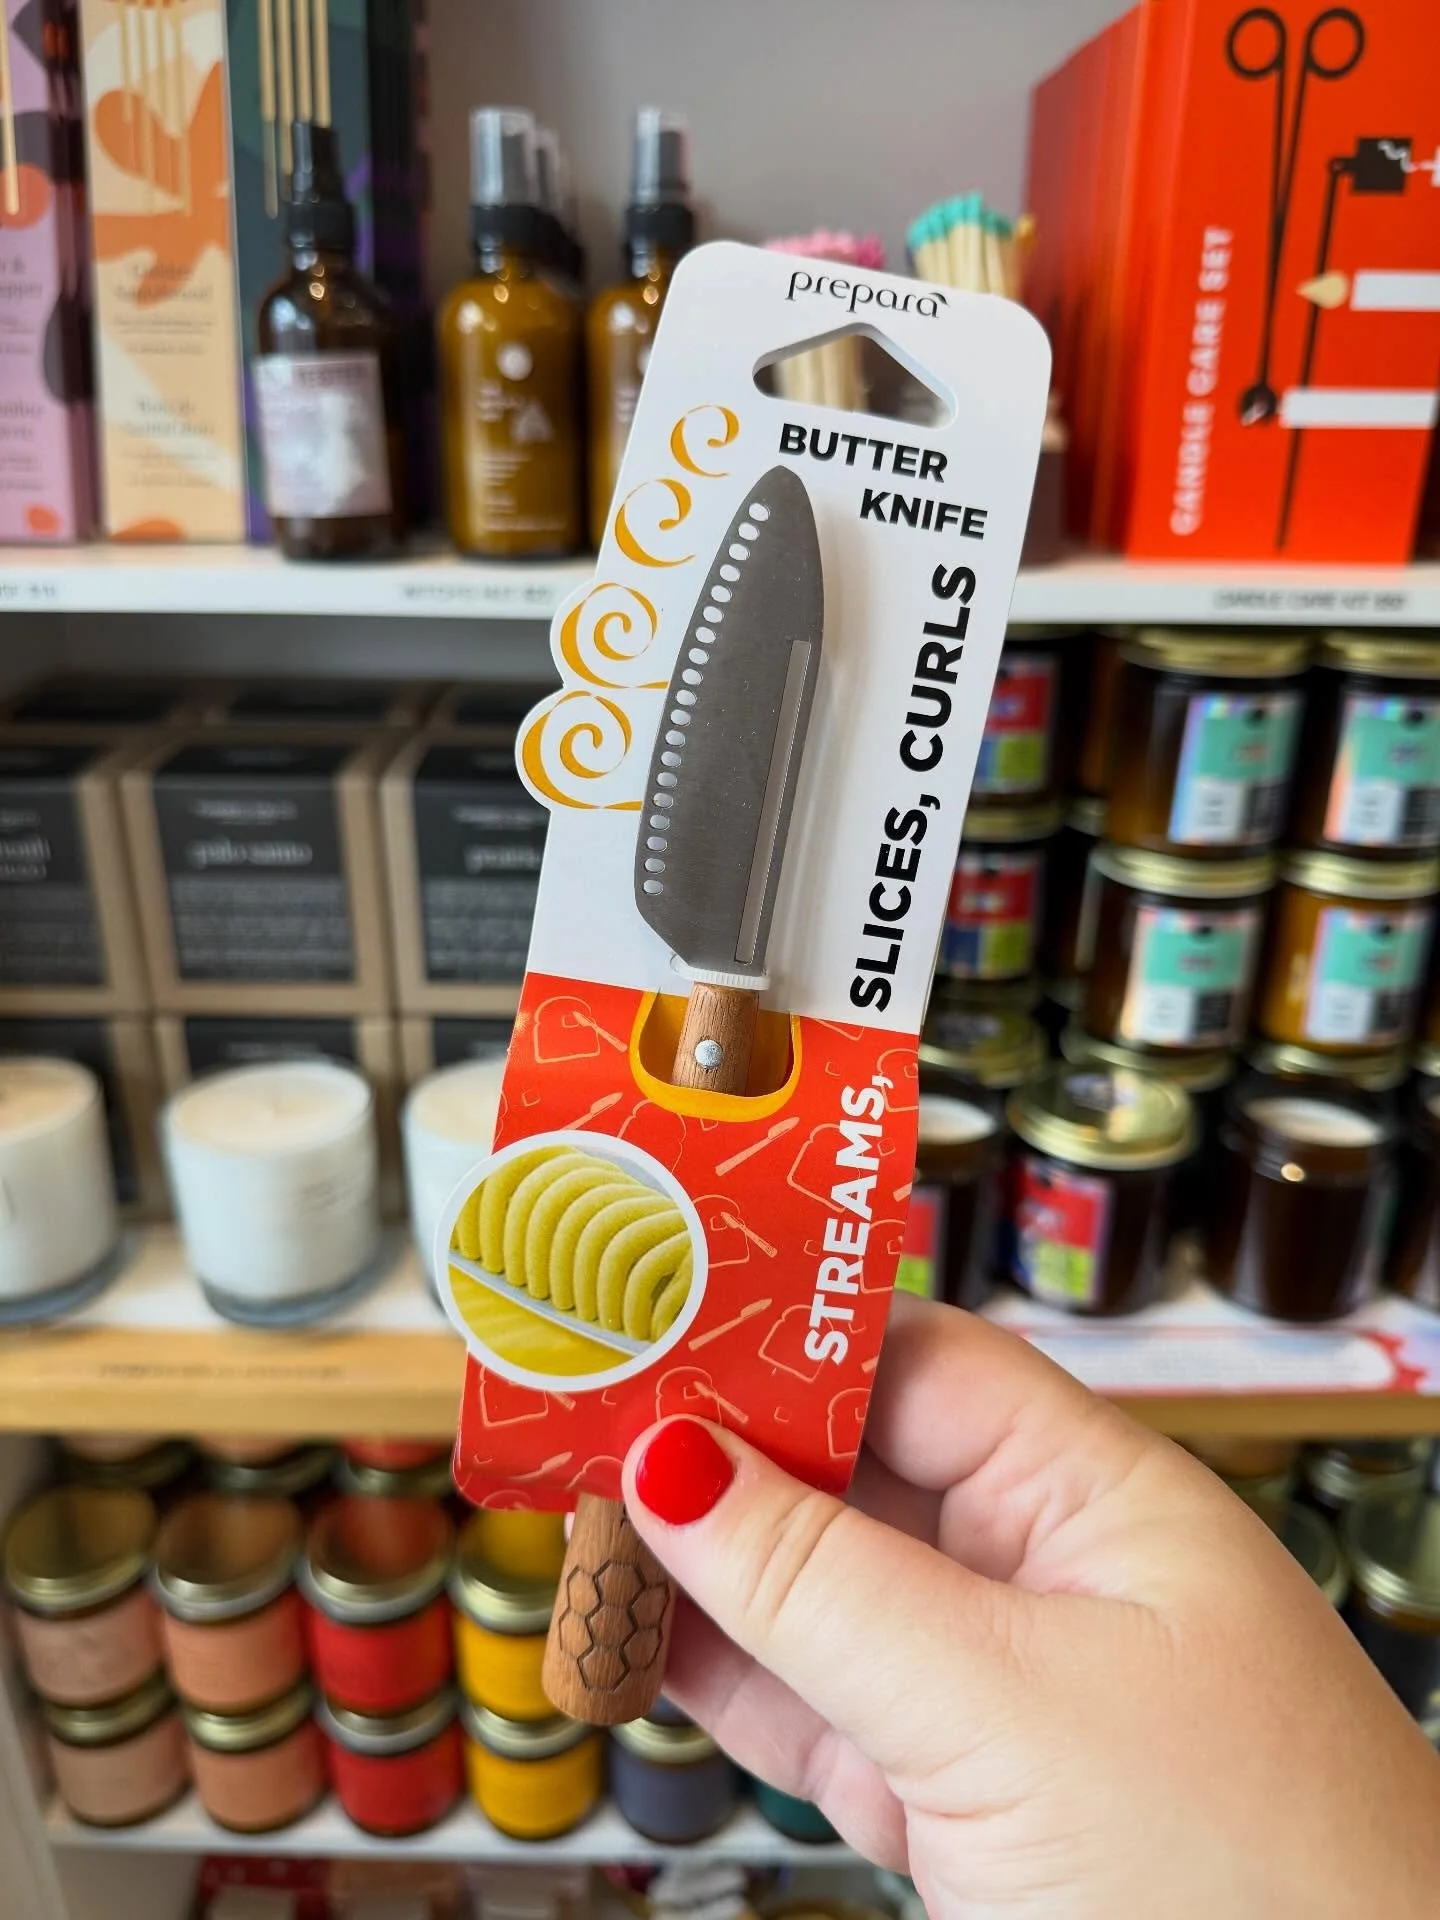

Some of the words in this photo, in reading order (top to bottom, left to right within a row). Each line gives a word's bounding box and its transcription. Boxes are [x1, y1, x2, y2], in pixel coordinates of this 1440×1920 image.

[1198, 226, 1233, 291] SET
[1187, 299, 1227, 396] CARE
[779, 423, 948, 483] BUTTER
[1170, 401, 1214, 535] CANDLE
[860, 489, 988, 540] KNIFE
[804, 1075, 894, 1366] STREAMS,
[850, 794, 941, 1013] SLICES,
[900, 564, 977, 772] CURLS
